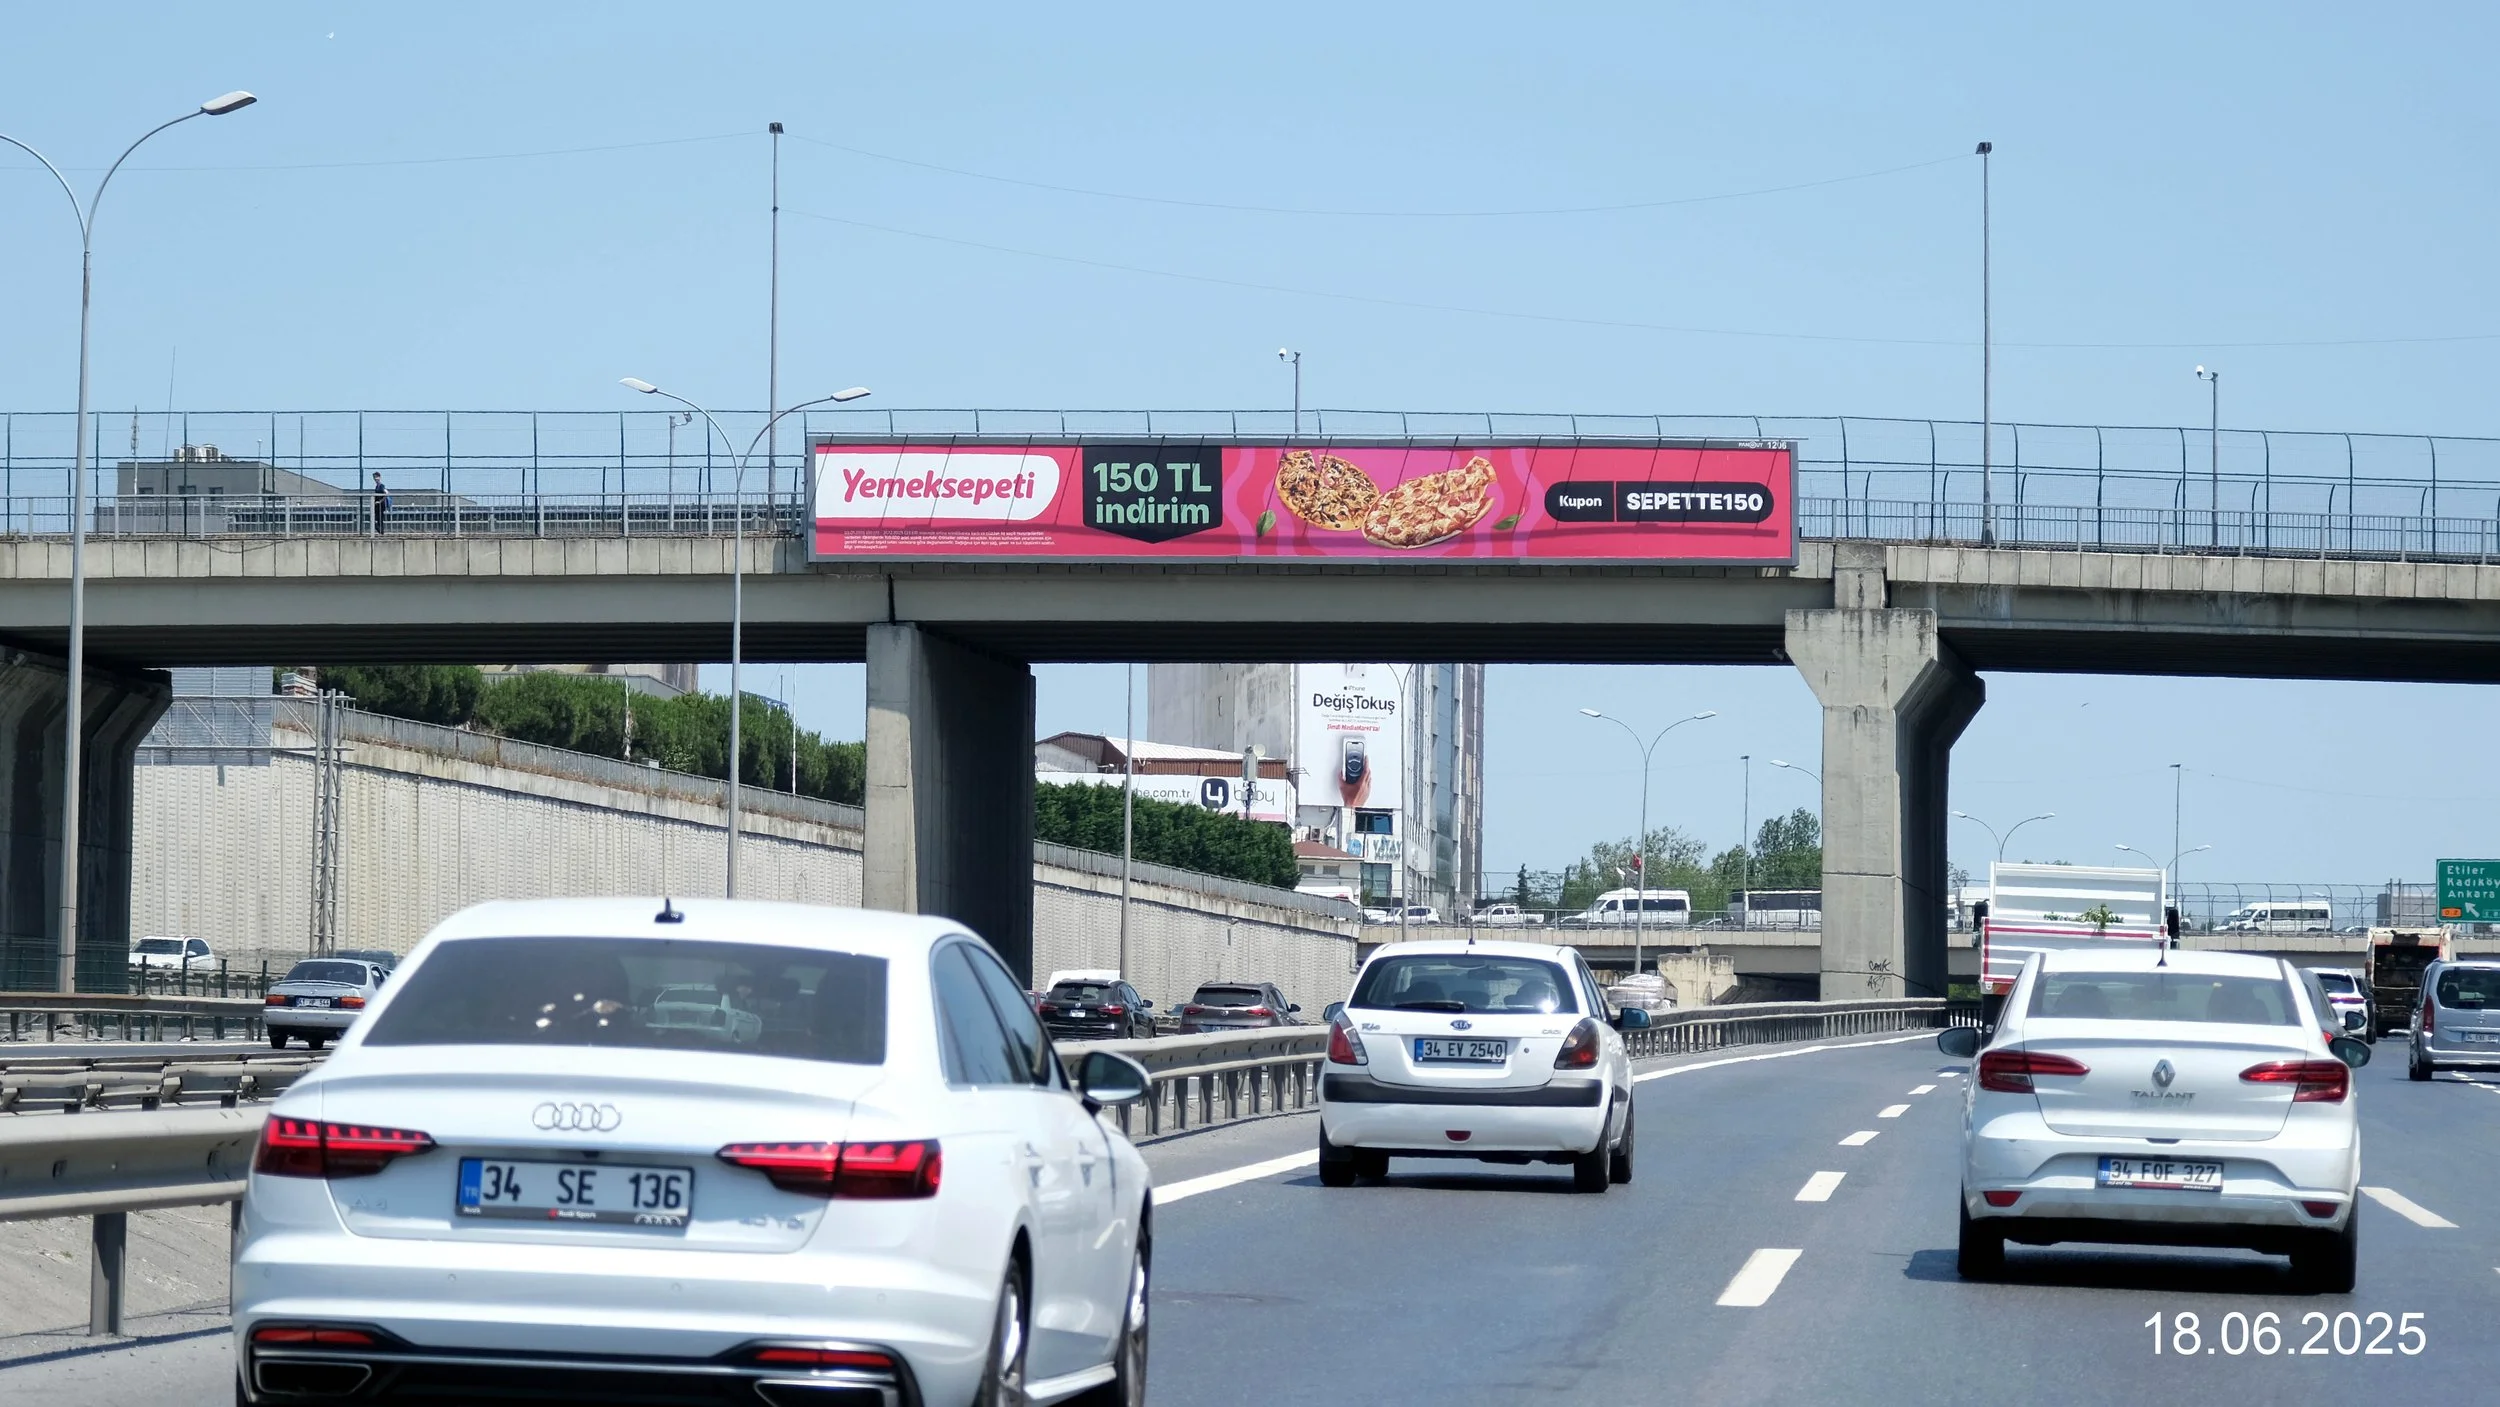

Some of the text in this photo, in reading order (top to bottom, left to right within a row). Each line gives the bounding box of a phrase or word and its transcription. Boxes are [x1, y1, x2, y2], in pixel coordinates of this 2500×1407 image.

[1093, 462, 1212, 493] 150 TL
[843, 467, 1036, 506] Yemeksepeti
[1096, 495, 1210, 525] indirim
[1559, 494, 1602, 511] Kupon
[1627, 492, 1764, 512] SEPETTE150
[1313, 693, 1396, 715] DeğişTokuş
[1234, 784, 1275, 806] bby
[2447, 865, 2486, 875] Etiler
[2447, 877, 2500, 889] Kadıköy
[2448, 890, 2496, 899] Ankara
[1362, 1022, 1381, 1031] Rio
[1453, 1021, 1469, 1030] KIA
[1425, 1042, 1503, 1058] 34 EV 2540
[2131, 1090, 2196, 1099] TALIANT
[2112, 1161, 2217, 1184] 34 FOF 327
[464, 1186, 480, 1199] TR
[483, 1165, 683, 1210] 34 SE 136
